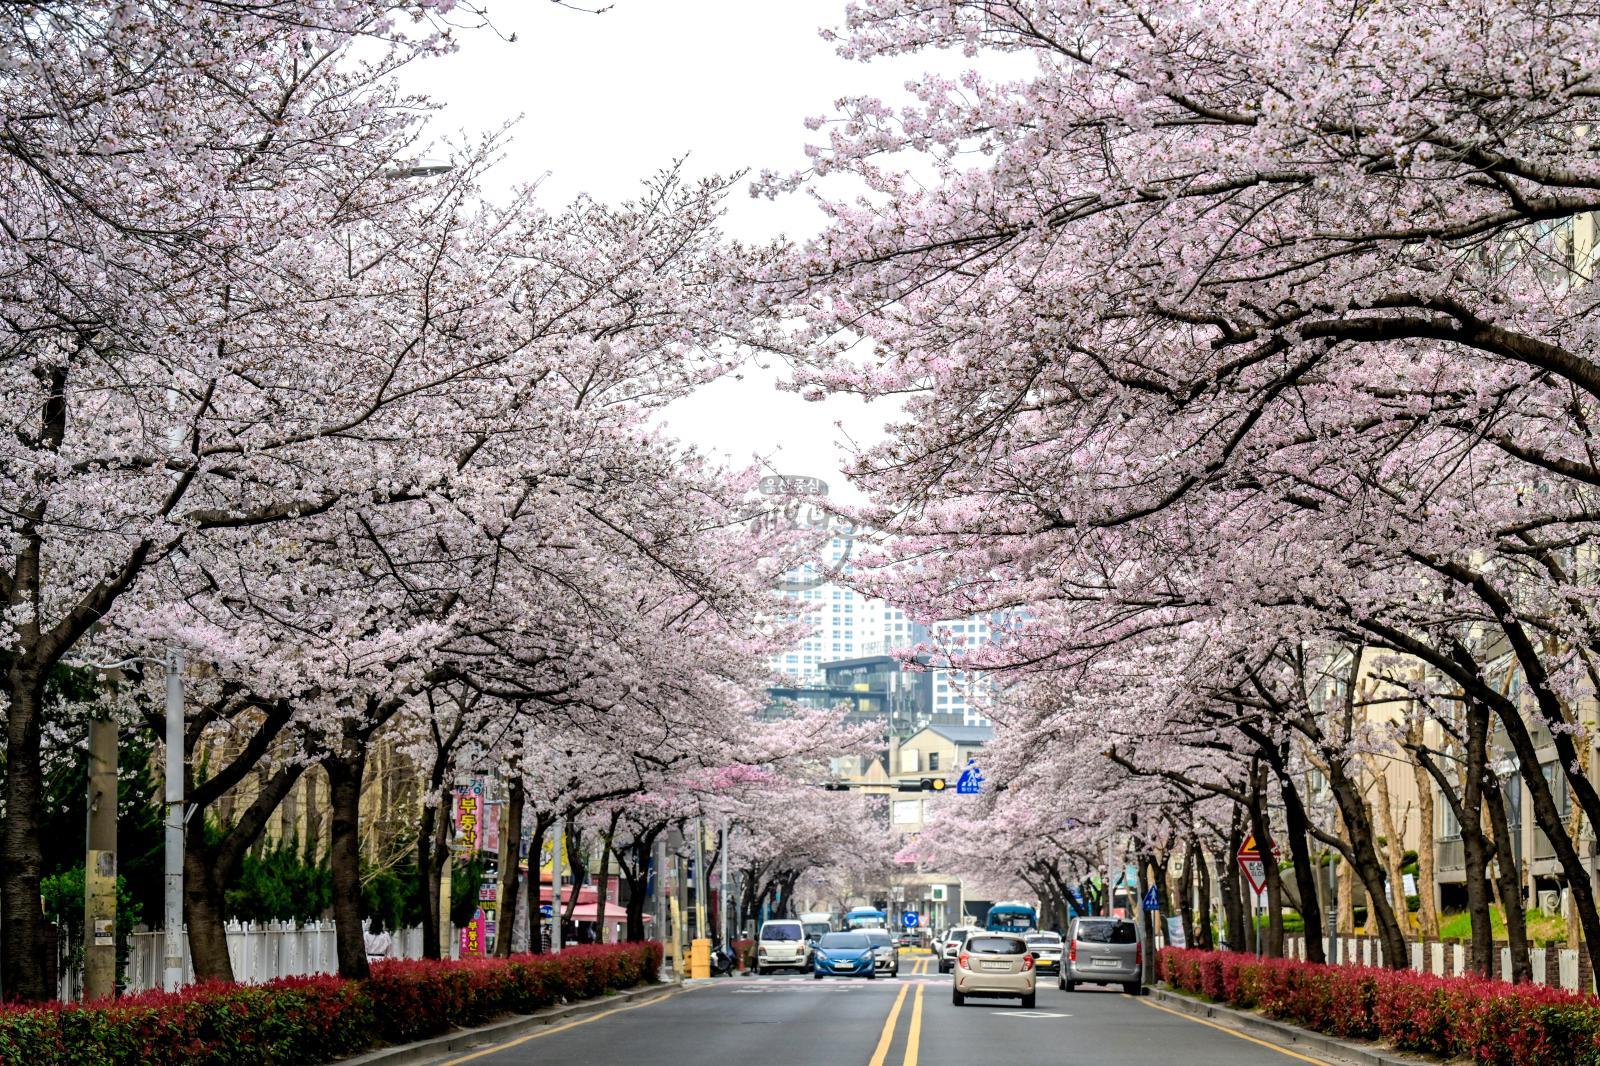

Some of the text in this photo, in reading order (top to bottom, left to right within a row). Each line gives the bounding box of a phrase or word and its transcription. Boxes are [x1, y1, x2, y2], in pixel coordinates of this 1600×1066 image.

[460, 797, 477, 848] 부동산
[479, 889, 497, 900] 부동
[467, 920, 479, 951] 부동산
